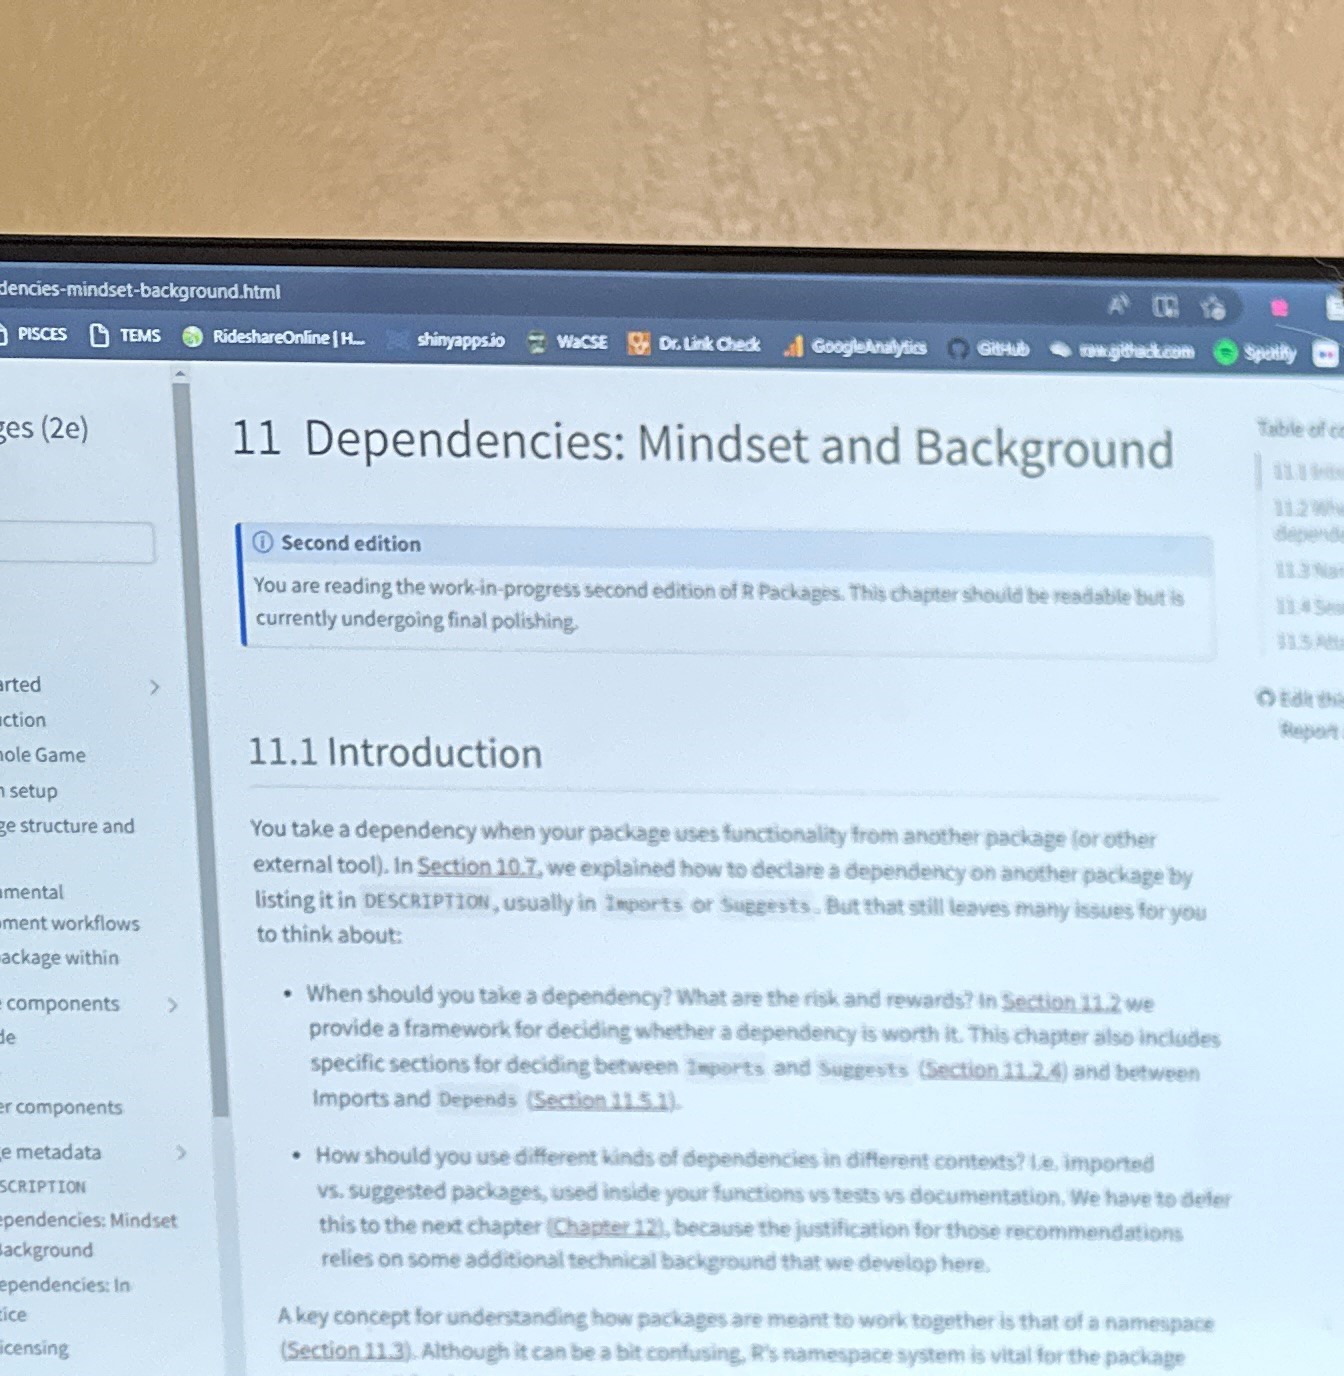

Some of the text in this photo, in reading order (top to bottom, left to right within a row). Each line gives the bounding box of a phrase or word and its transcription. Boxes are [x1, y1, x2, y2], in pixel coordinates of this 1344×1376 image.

[18, 326, 68, 342] PISCES
[119, 328, 162, 343] TEMS
[213, 328, 331, 345] RideshareOnline
[417, 331, 506, 351] shinyapps.io
[556, 334, 608, 350] WaCSE
[658, 335, 761, 352] Dr. Link Check
[811, 338, 928, 359] GoogleAnalytics
[977, 340, 1031, 357] GitHub
[1244, 343, 1297, 365] Spotify
[42, 415, 87, 443] (2e)
[235, 419, 1172, 478] 11 Dependencies: Mindset and Background
[281, 534, 422, 553] Second edition
[253, 576, 1185, 607] You are reading the work-in-progress second edition of R Packages. This chapter should be readable but is
[255, 609, 578, 634] currently undergoing final polishing.
[34, 746, 87, 764] Game
[251, 736, 541, 768] 11.1 Introduction
[9, 783, 59, 803] setup
[19, 817, 136, 835] structure and
[249, 818, 585, 846] You take dependency when your
[50, 914, 141, 932] workflows
[15, 1142, 102, 1161] metadata
[109, 1212, 178, 1229] Mindset
